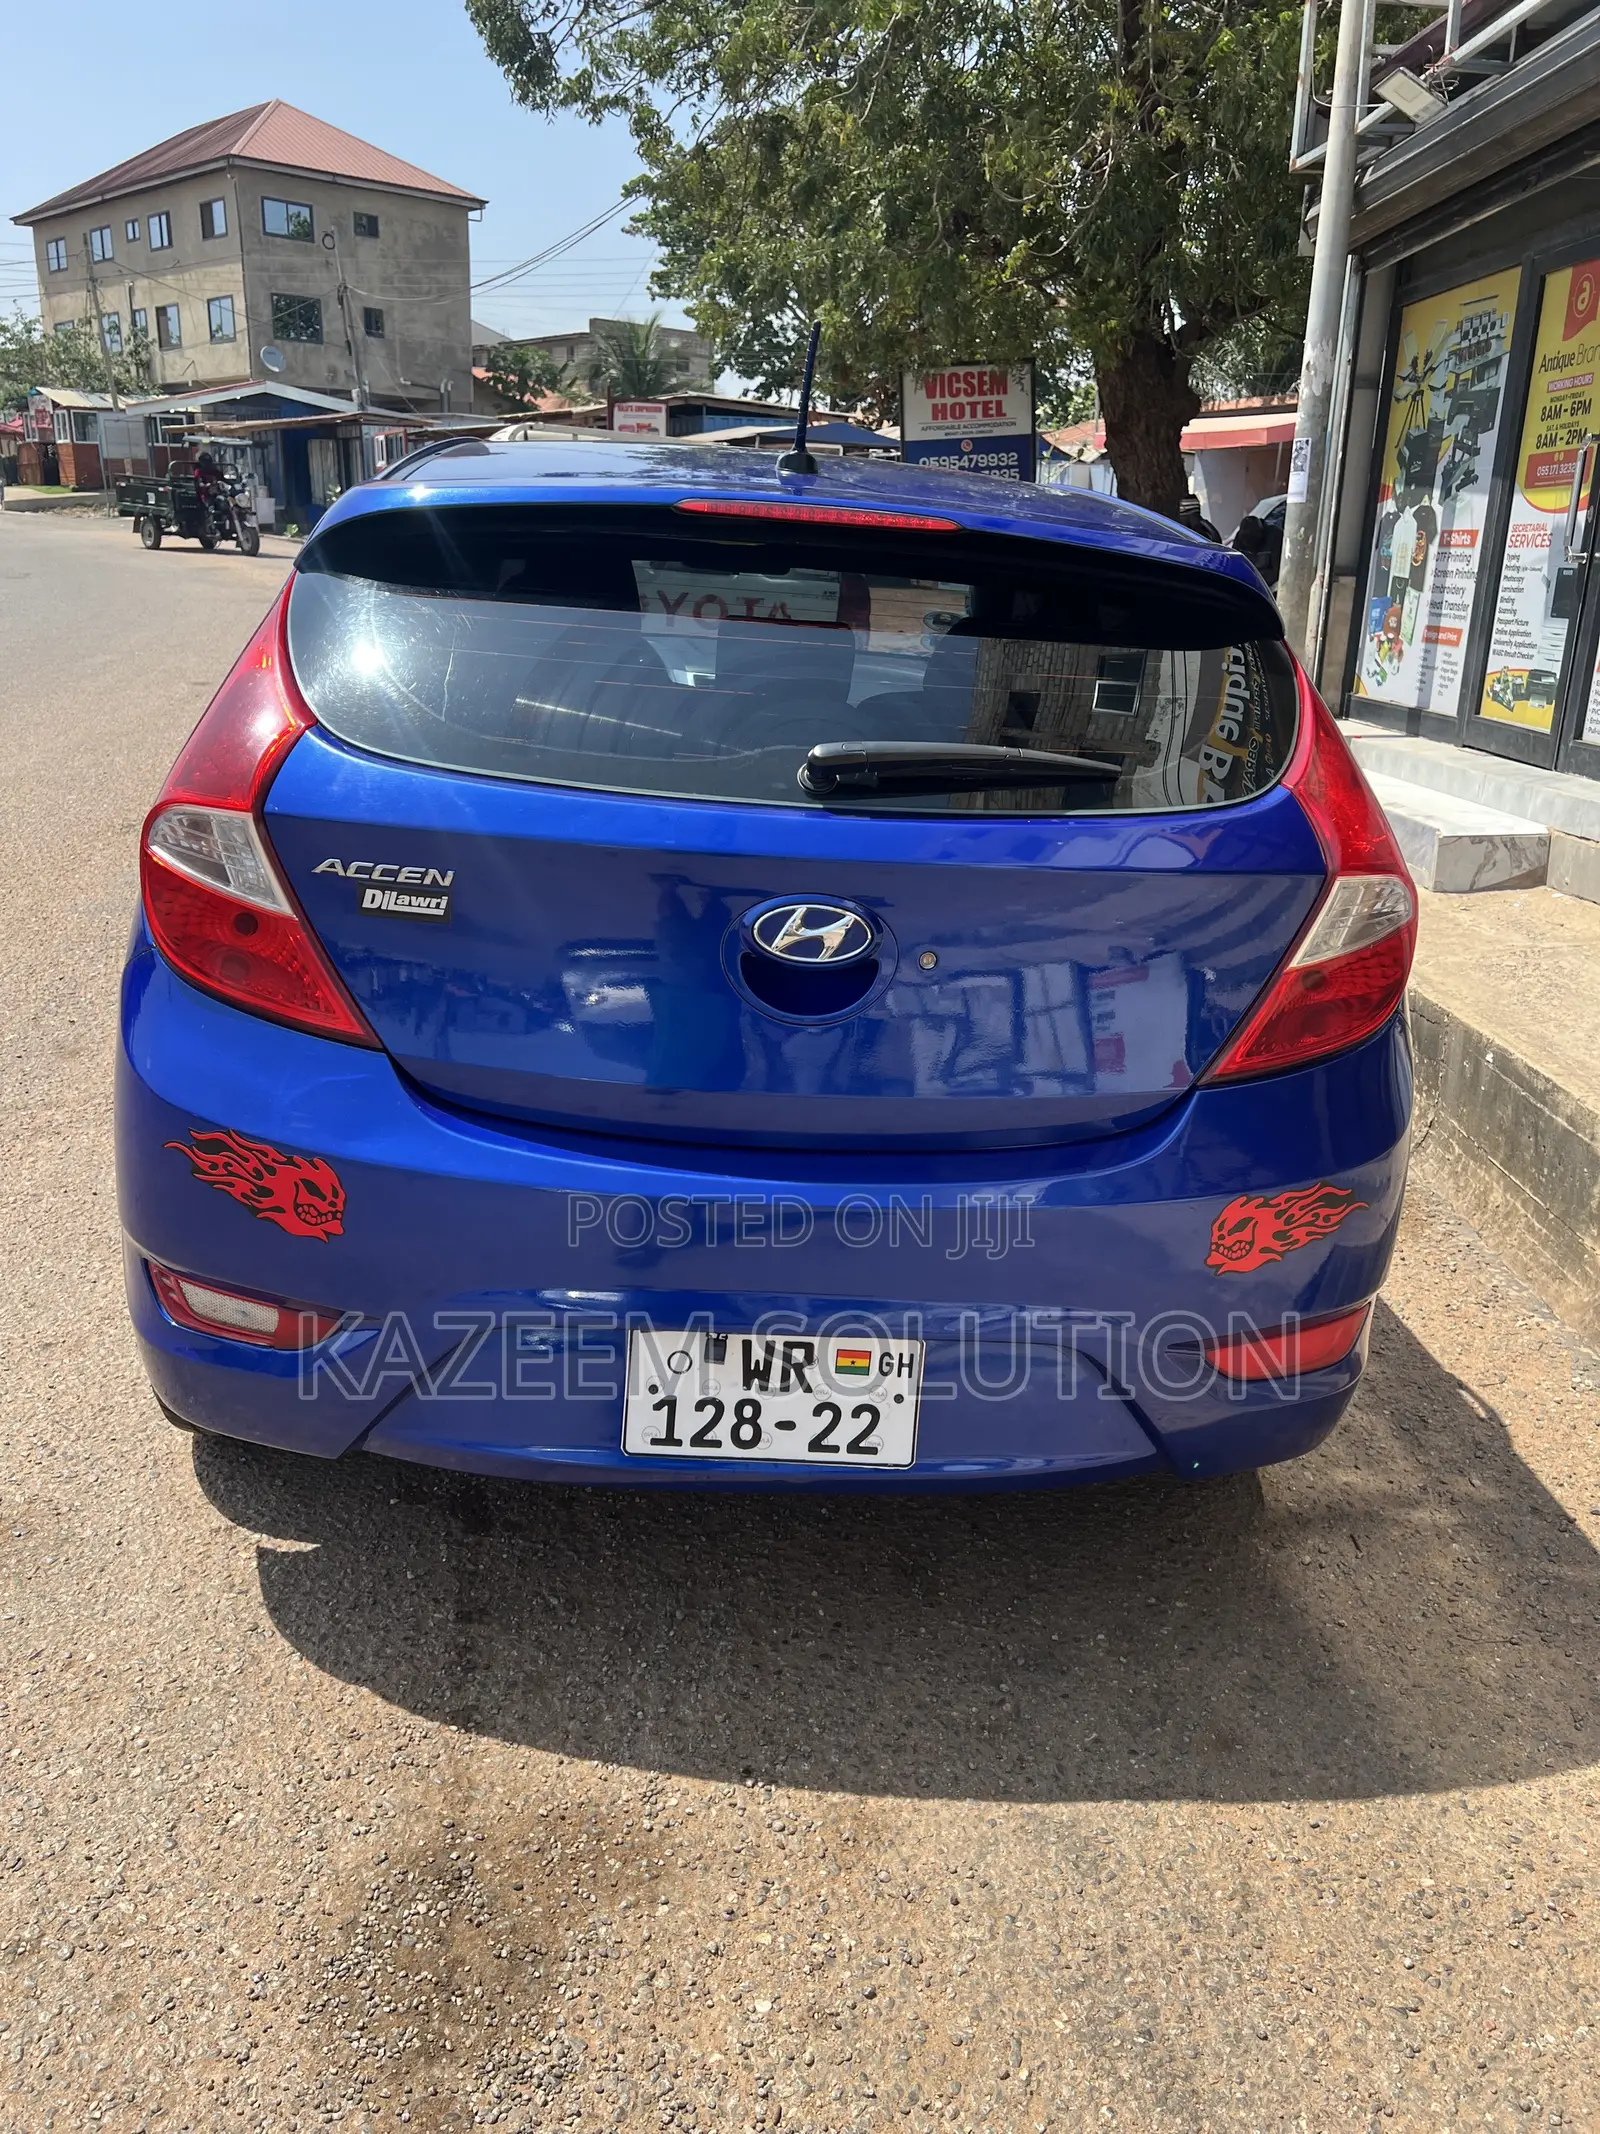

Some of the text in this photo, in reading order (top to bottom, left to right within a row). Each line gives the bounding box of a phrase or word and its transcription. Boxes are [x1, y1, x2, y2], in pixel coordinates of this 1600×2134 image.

[1538, 350, 1576, 373] Antique
[923, 370, 1009, 400] VICSEM
[1548, 373, 1594, 392] WORKING HOURS
[931, 399, 1007, 421] HOTEL
[1541, 404, 1563, 422] 8AM
[1570, 397, 1592, 417] 6PM
[921, 421, 1017, 432] AFFORDABLE ACCOMMODATION
[1536, 432, 1559, 450] 8AM
[1565, 427, 1588, 446] 2PM
[919, 452, 1018, 471] 0595479932
[1536, 465, 1550, 477] 055
[1511, 522, 1548, 533] SECRETARIAL
[1508, 532, 1553, 549] SERVICES
[1436, 551, 1471, 567] DTF Printing
[1506, 552, 1521, 563] Typing
[1434, 568, 1454, 578] Screen
[1504, 563, 1521, 574] Printing
[1503, 574, 1525, 585] Photocopy
[1431, 583, 1466, 600] Embroidery
[1501, 585, 1525, 593] Lamination
[1429, 600, 1469, 612] Heat Transfer
[1499, 595, 1516, 606] Binding
[1498, 606, 1517, 617] Scanning
[1496, 617, 1529, 627] Passport Picture
[1495, 627, 1532, 638] Online Application
[1493, 638, 1538, 650] University Application
[311, 858, 455, 887] ACCEN
[742, 1339, 914, 1394] WR GH
[650, 1396, 881, 1456] 128-22
